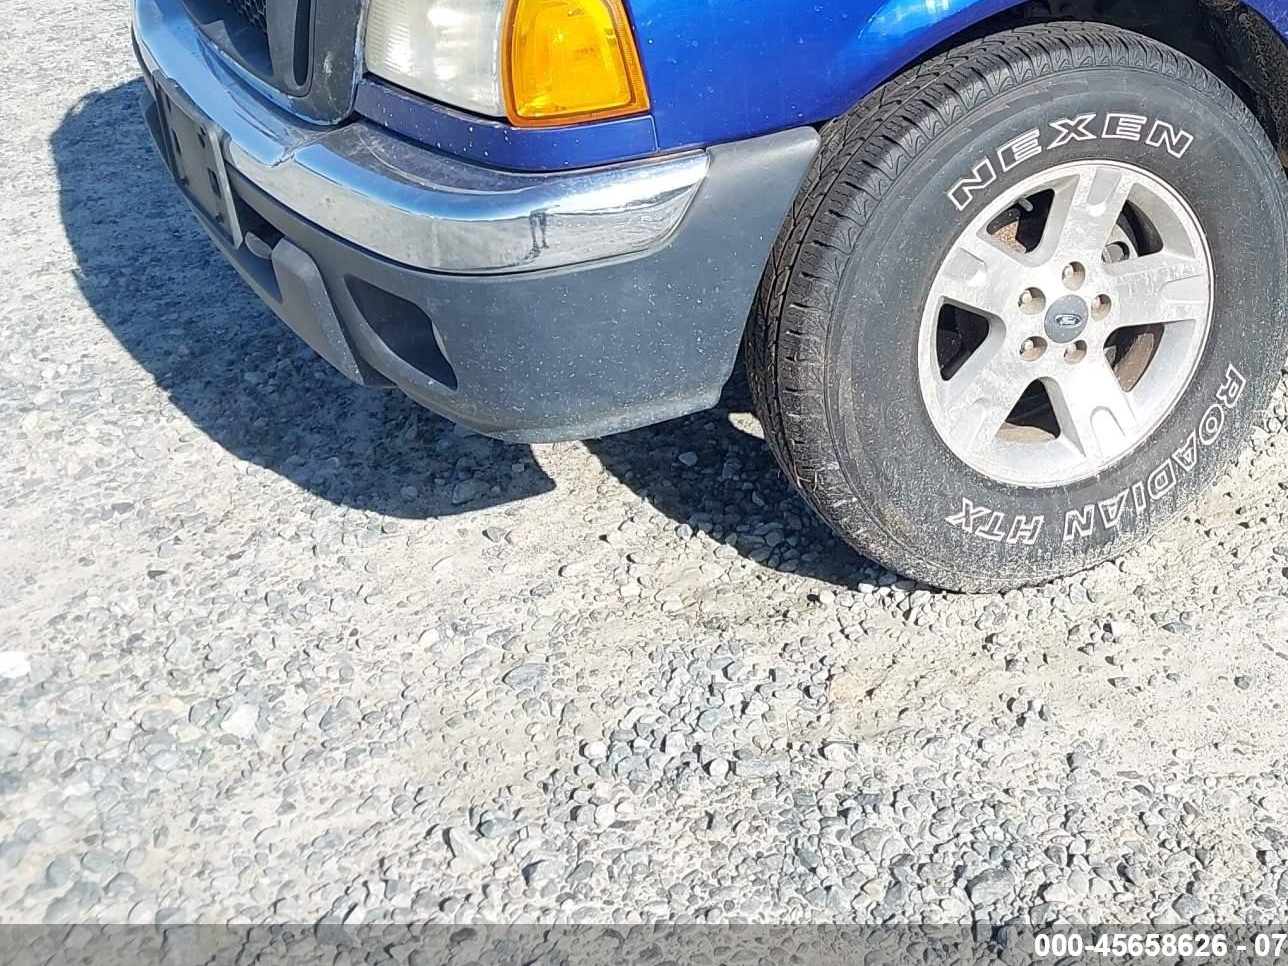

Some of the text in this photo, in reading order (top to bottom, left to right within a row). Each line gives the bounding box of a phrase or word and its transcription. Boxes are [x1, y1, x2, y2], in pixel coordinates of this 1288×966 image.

[947, 112, 1194, 211] NEXEN
[944, 364, 1247, 545] ROADIAN HTX
